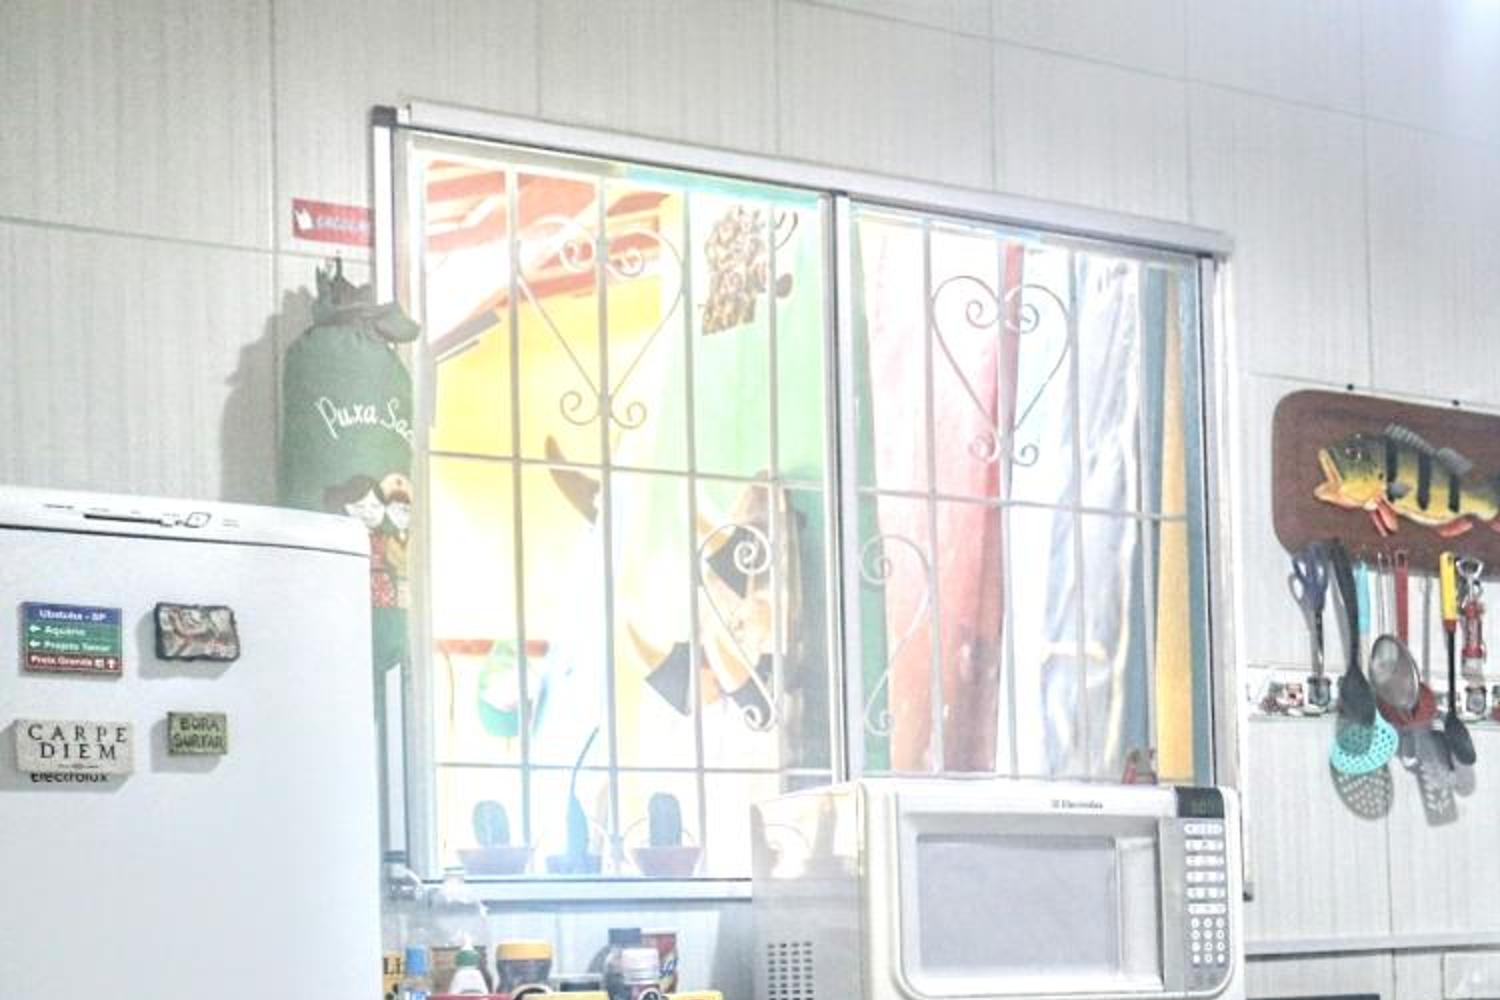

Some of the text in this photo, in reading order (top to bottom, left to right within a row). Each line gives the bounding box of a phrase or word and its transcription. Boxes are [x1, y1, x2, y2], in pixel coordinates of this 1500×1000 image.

[314, 396, 417, 447] Puxa Sac
[39, 608, 83, 621] Ubatuba
[27, 722, 129, 744] CARPE
[179, 717, 220, 732] BORA
[40, 743, 117, 761] DIEM
